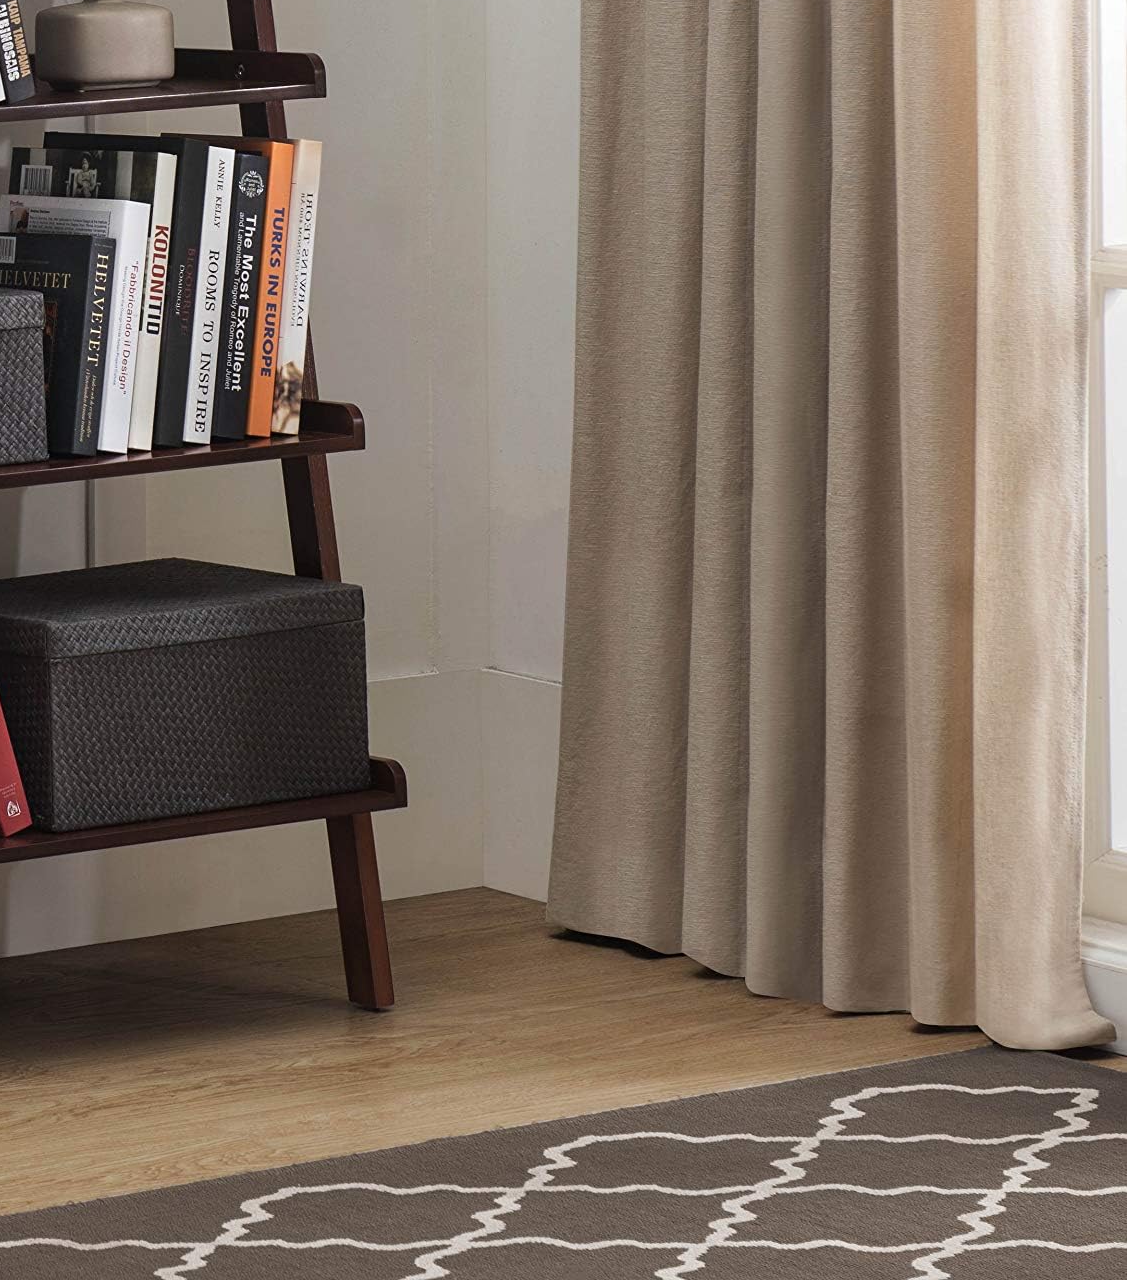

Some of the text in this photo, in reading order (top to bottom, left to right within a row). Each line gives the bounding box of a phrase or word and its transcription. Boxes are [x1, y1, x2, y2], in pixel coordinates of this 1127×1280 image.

[214, 159, 225, 228] ANNIE KELLY
[231, 278, 239, 310] Tragedy
[234, 229, 244, 275] Lamentable
[260, 207, 285, 378] TURKS IN EUROPE
[87, 253, 109, 367] HELVETET
[195, 249, 220, 433] ROOMS TO INSPIRE
[228, 321, 236, 350] Romeo
[231, 214, 257, 391] The Most Excellent
